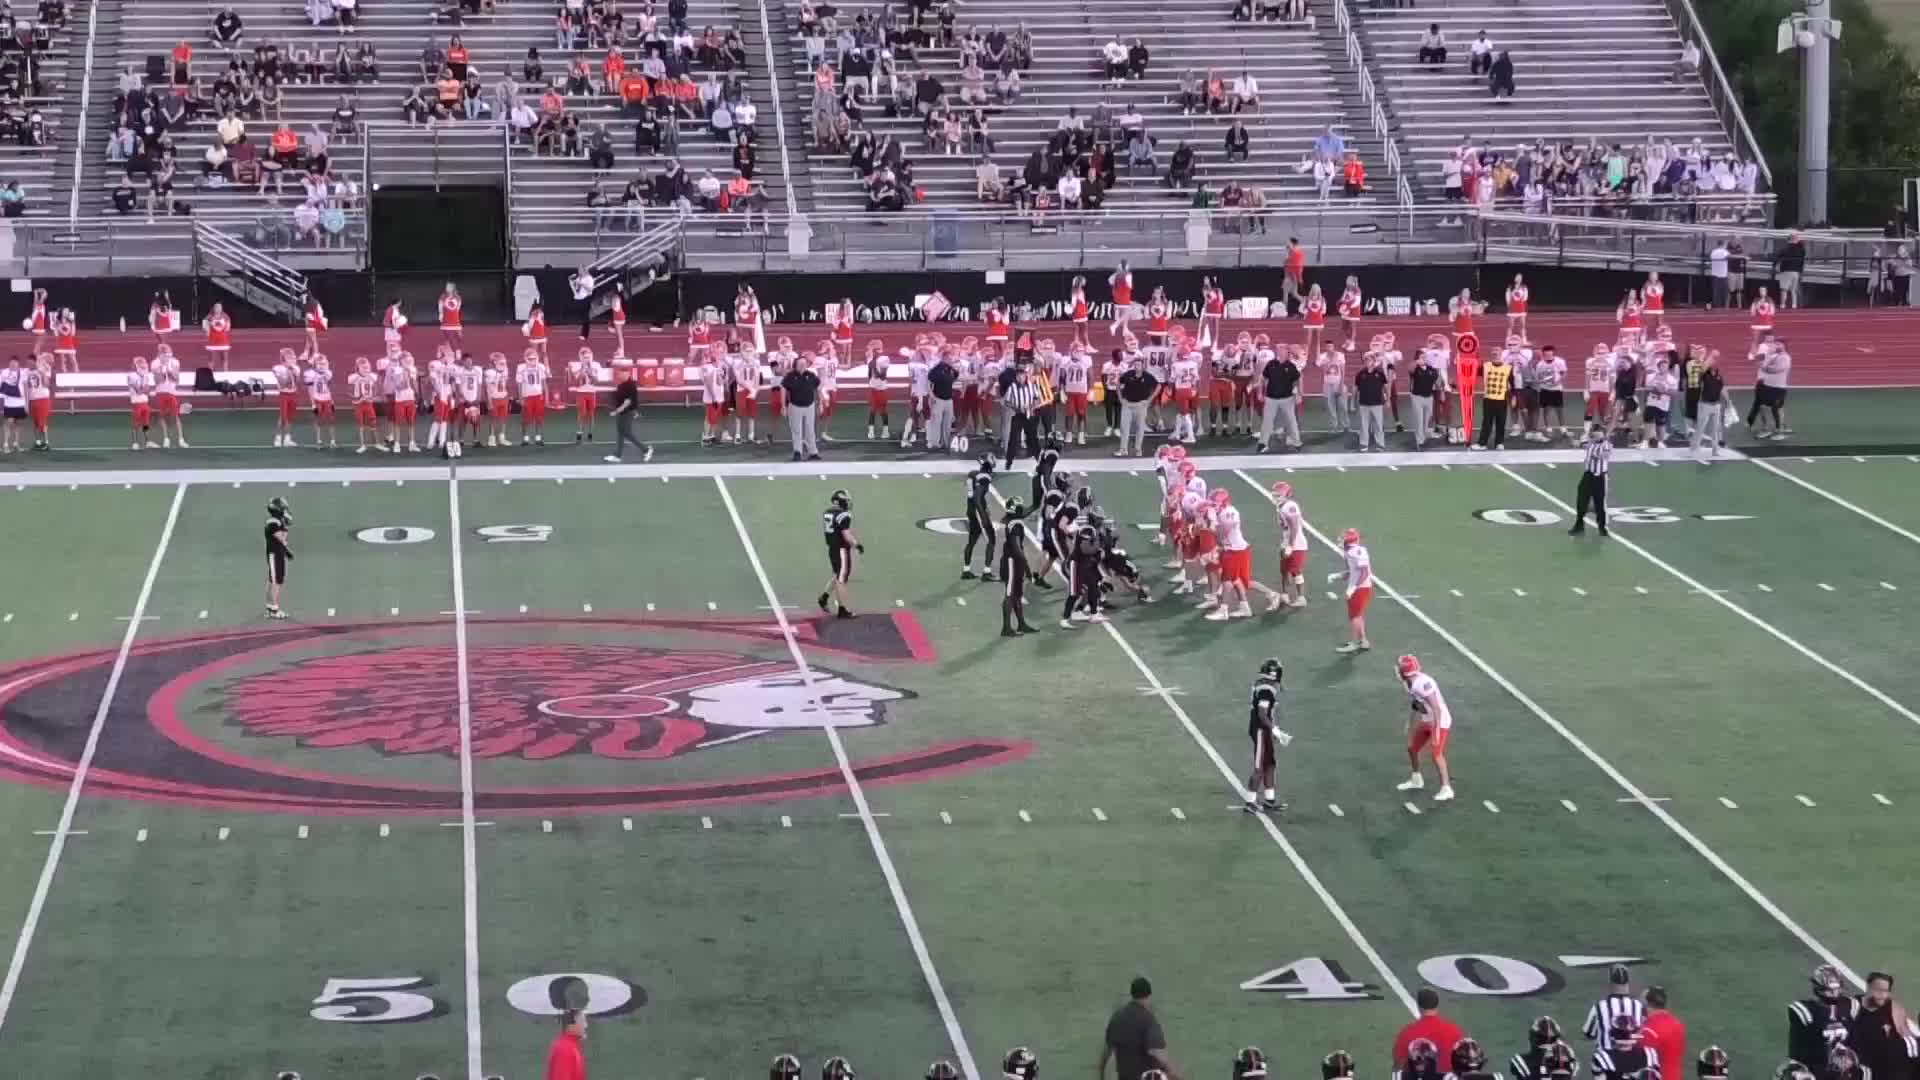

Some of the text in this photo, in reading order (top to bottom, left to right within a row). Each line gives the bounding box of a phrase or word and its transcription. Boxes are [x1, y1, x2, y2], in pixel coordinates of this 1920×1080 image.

[446, 441, 462, 457] 50
[950, 437, 969, 453] 40
[1239, 953, 1548, 1000] 40
[308, 972, 633, 1022] 50
